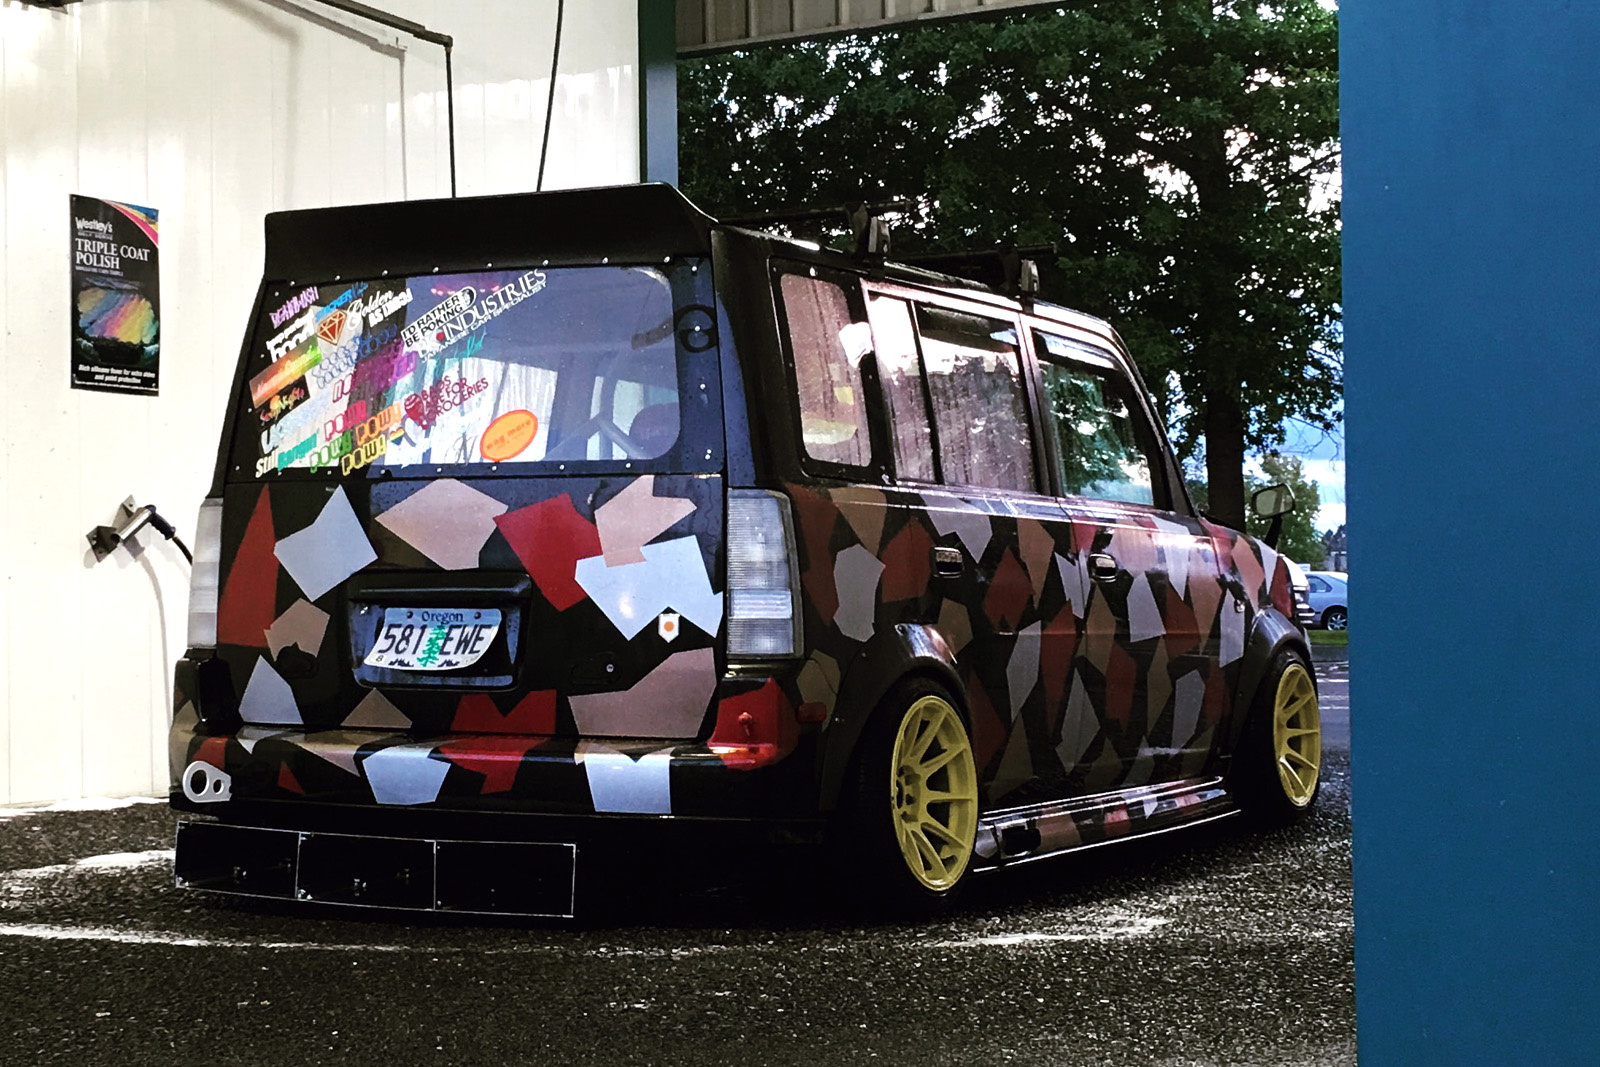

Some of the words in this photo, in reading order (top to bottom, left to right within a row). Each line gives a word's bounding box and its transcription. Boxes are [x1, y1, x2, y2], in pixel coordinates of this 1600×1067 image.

[75, 216, 113, 234] Westley's
[75, 238, 118, 256] TRIPLE
[120, 245, 150, 261] COAT
[76, 251, 120, 269] POLISH
[346, 290, 394, 330] Golden
[402, 326, 416, 339] I'D
[417, 295, 460, 329] RATHER
[443, 269, 547, 341] INDUSTRIES
[405, 334, 420, 347] BE
[421, 304, 463, 337] POKING
[472, 315, 492, 331] CAR
[421, 375, 451, 401] BAGS
[427, 377, 489, 420] GROCERIES
[446, 377, 469, 397] FOR
[507, 419, 531, 436] more
[341, 434, 388, 476] POW!
[421, 610, 464, 625] Oregon
[378, 624, 428, 655] 581
[438, 624, 493, 655] EWE
